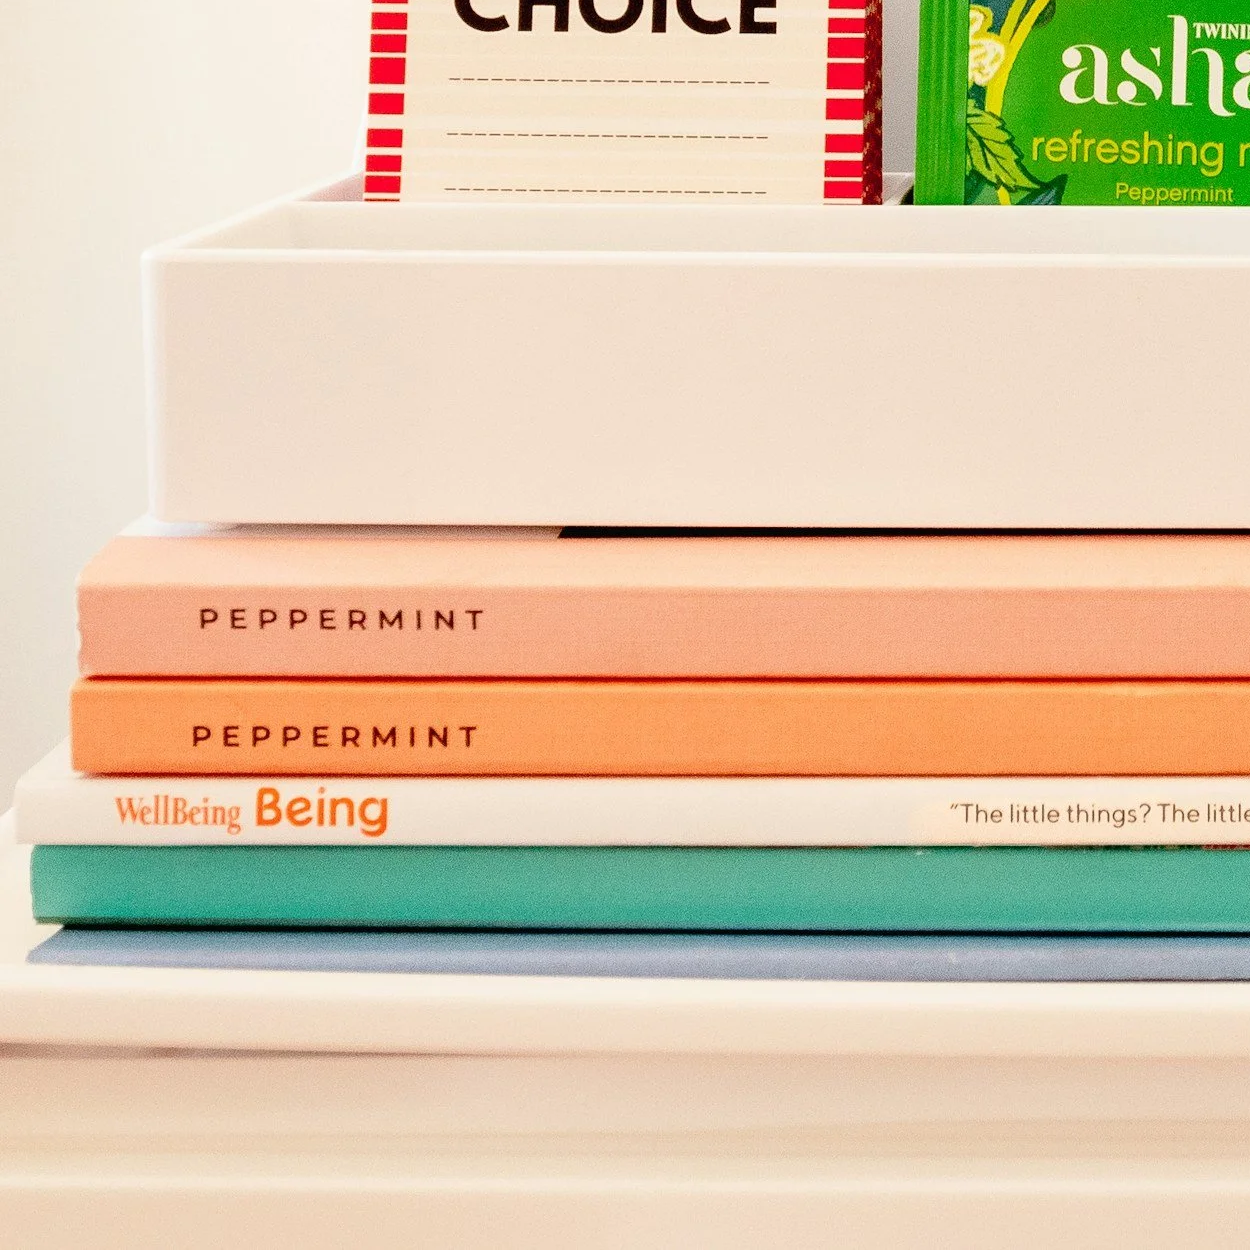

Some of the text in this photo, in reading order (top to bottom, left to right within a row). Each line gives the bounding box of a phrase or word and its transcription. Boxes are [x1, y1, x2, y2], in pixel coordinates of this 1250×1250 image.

[1032, 129, 1224, 177] refreshing
[1115, 182, 1233, 206] Peppermint
[200, 608, 484, 630] PEPPERMINT
[192, 726, 478, 748] PEPPERMINT
[115, 787, 389, 837] WellBeing Being
[1009, 803, 1060, 823] little
[1067, 803, 1151, 828] things?
[1157, 803, 1200, 823] The
